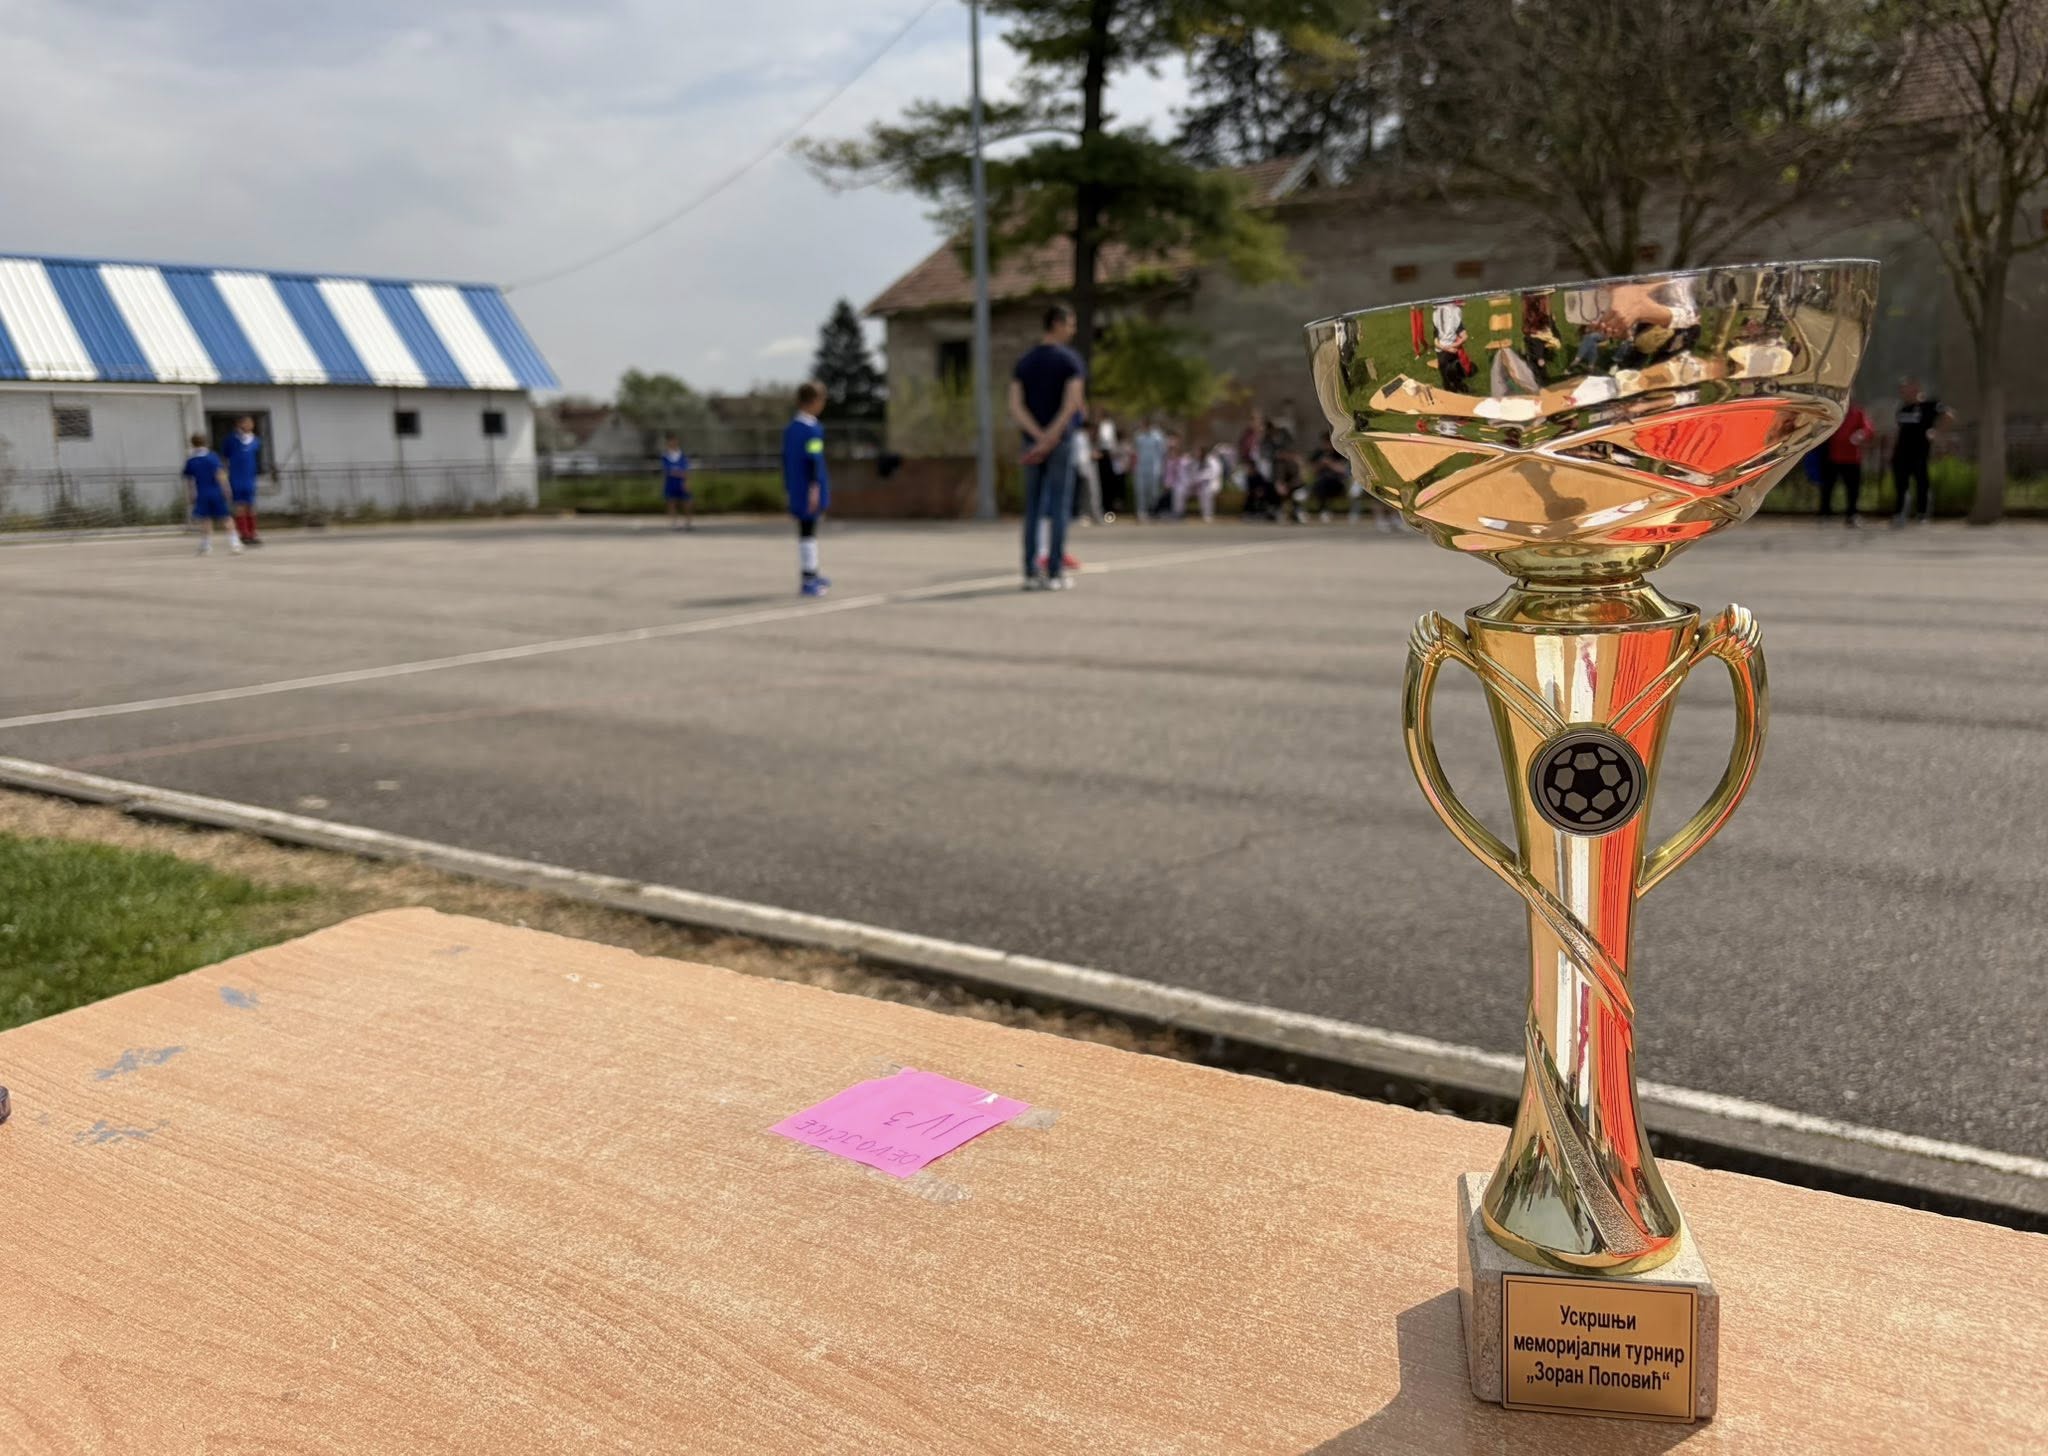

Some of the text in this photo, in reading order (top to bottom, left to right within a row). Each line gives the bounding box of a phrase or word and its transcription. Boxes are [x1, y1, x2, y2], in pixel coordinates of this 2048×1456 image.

[1560, 1305, 1636, 1330] Ускршњи
[1513, 1335, 1685, 1368] меморијални турнир
[1526, 1361, 1670, 1390] „Зоран Поповић“
